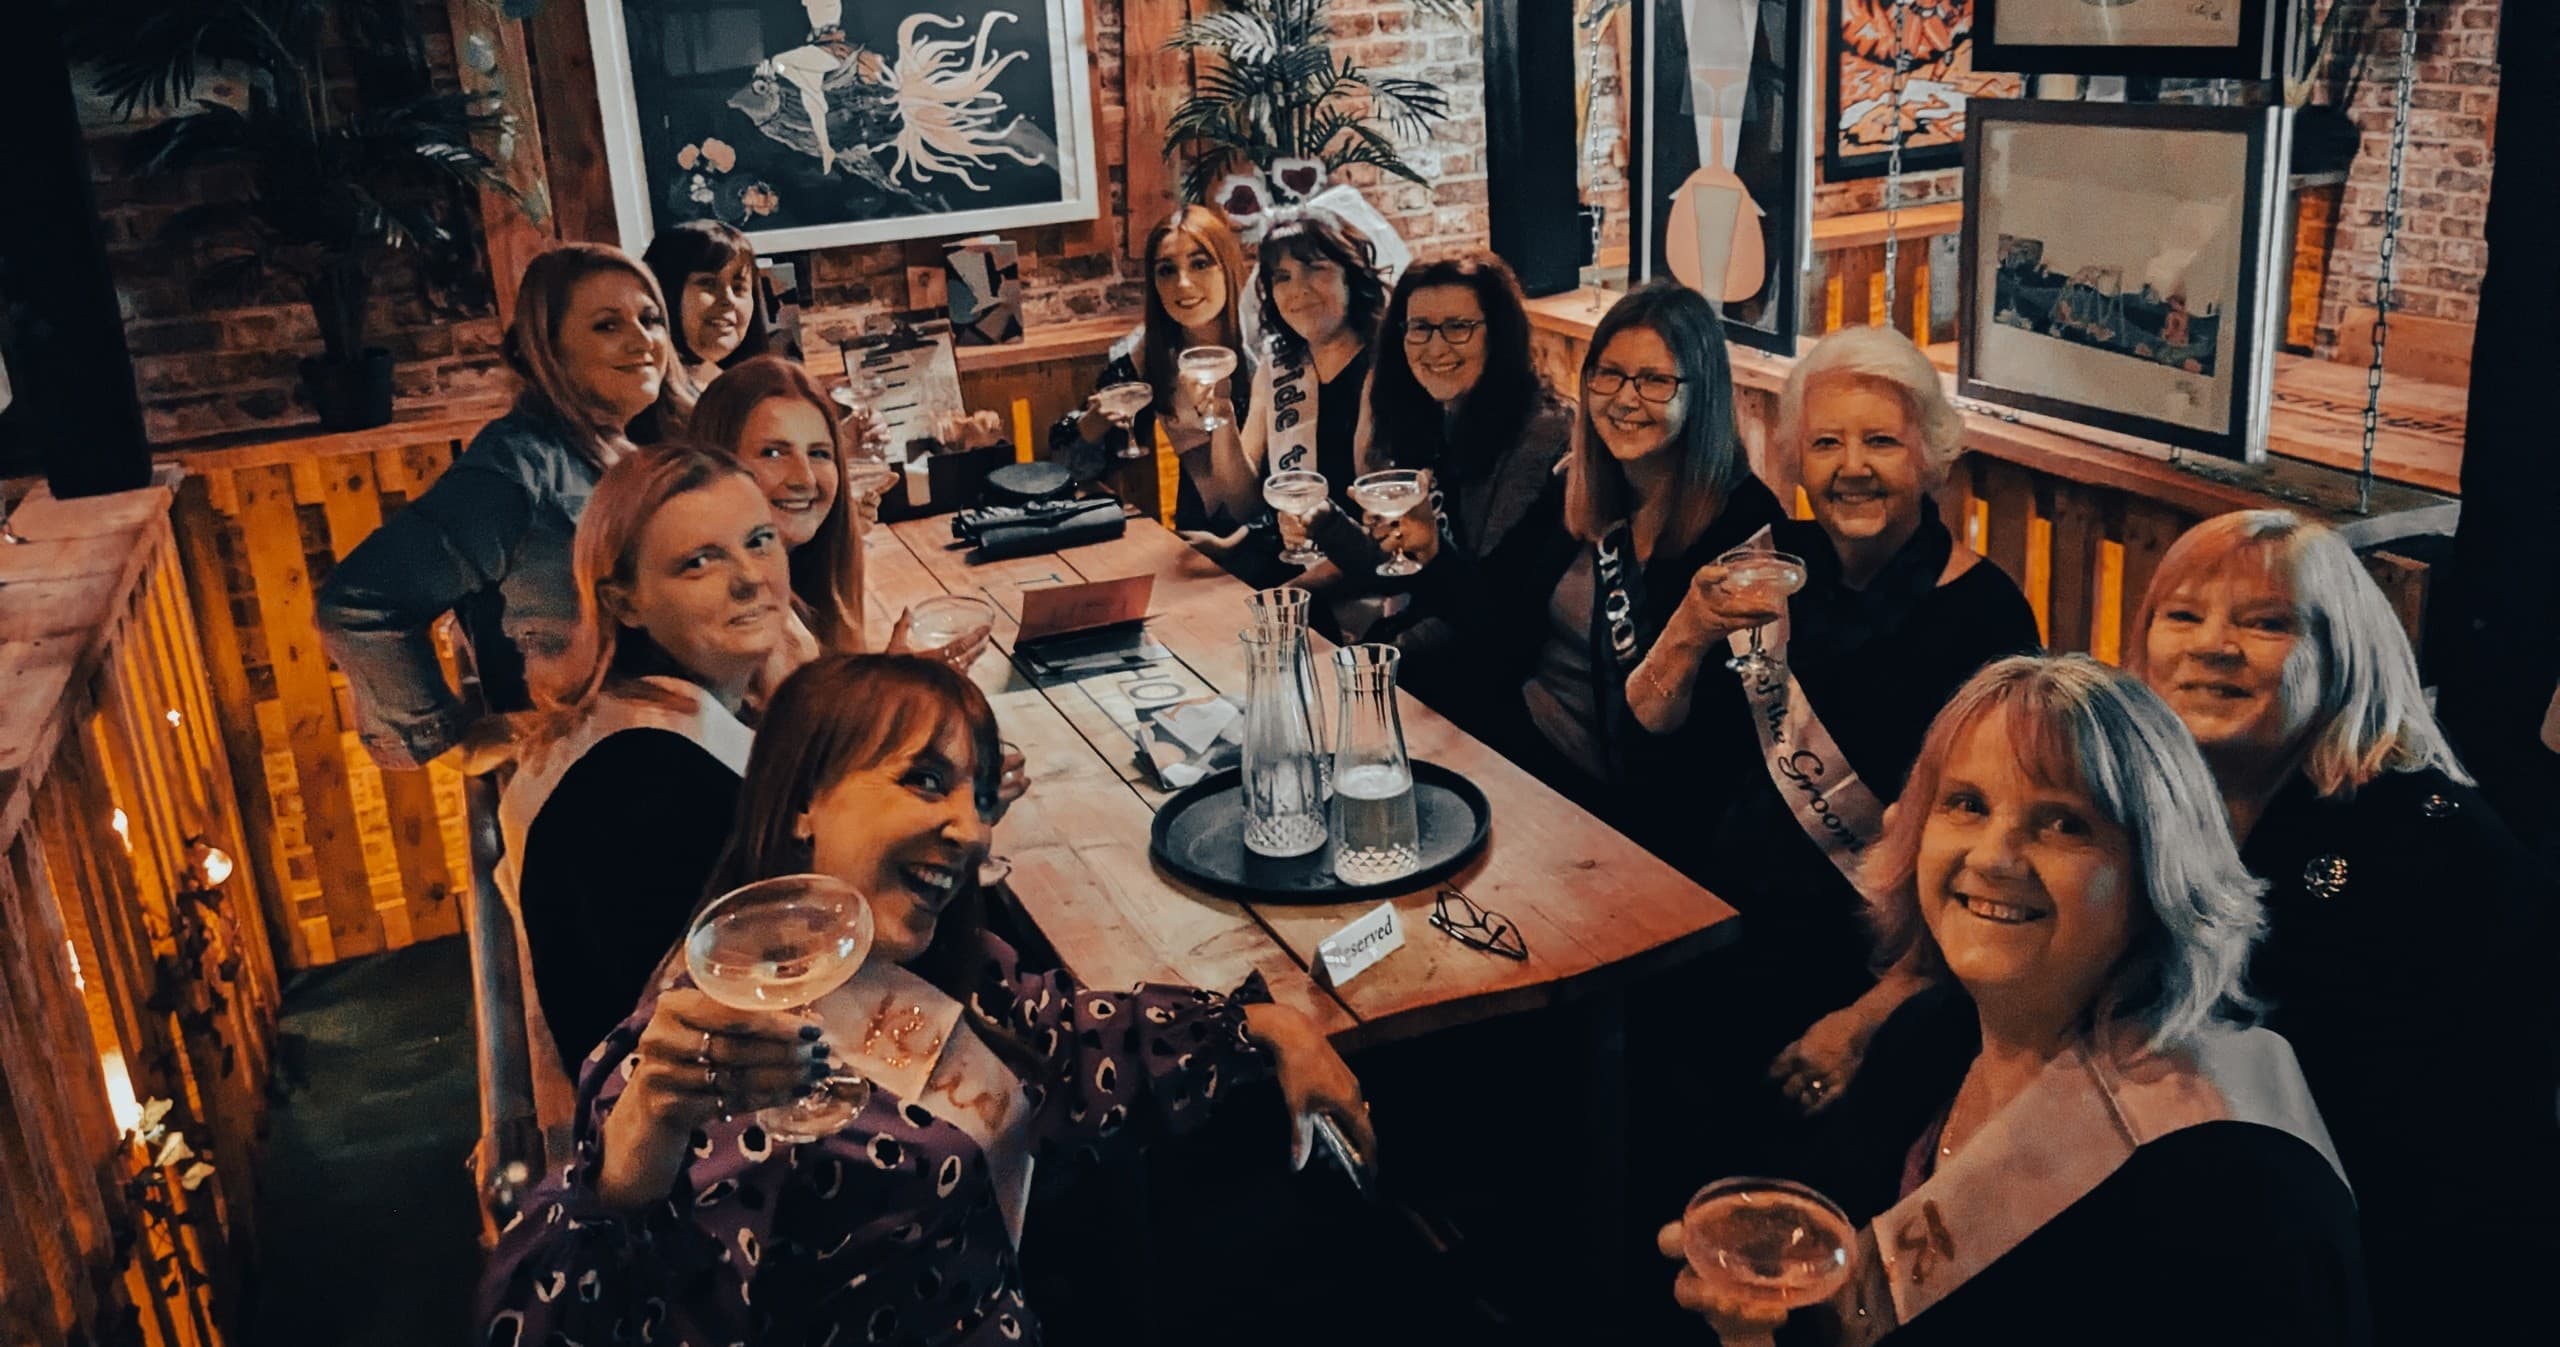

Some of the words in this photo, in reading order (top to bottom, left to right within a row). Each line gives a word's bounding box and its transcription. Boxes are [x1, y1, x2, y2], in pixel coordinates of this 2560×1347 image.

[1279, 444, 1308, 472] t
[1598, 518, 1637, 659] Groo
[1766, 702, 1788, 744] the
